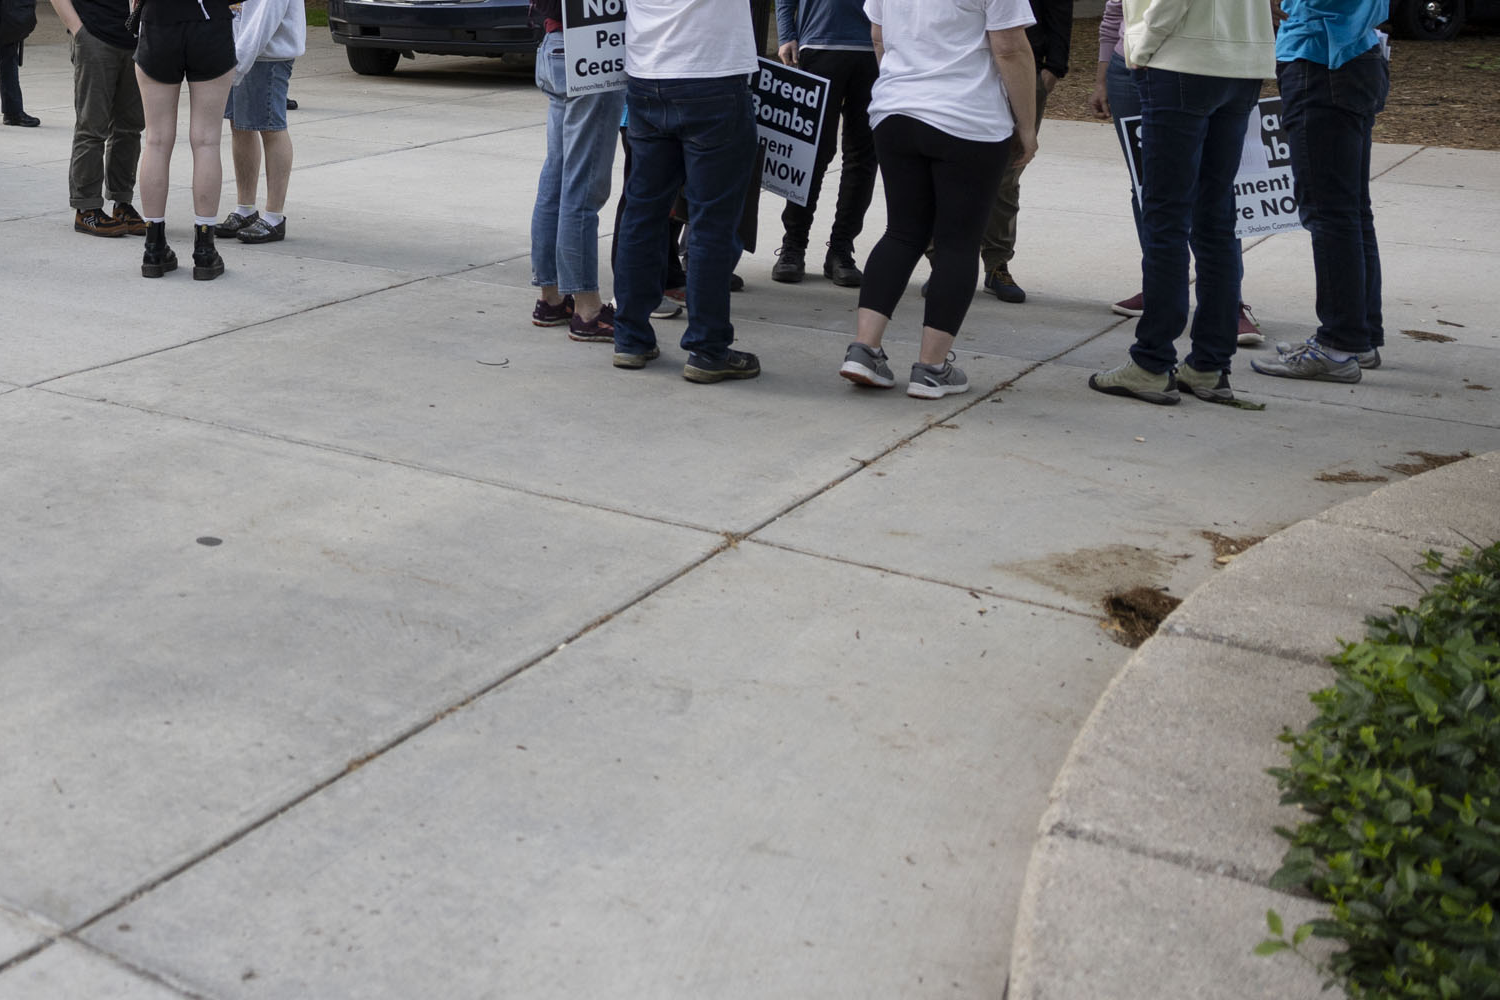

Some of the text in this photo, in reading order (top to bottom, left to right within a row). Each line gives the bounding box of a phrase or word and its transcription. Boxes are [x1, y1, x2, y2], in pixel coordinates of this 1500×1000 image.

[759, 67, 820, 109] Bread
[764, 157, 806, 187] NOW
[1247, 225, 1271, 234] Shalom
